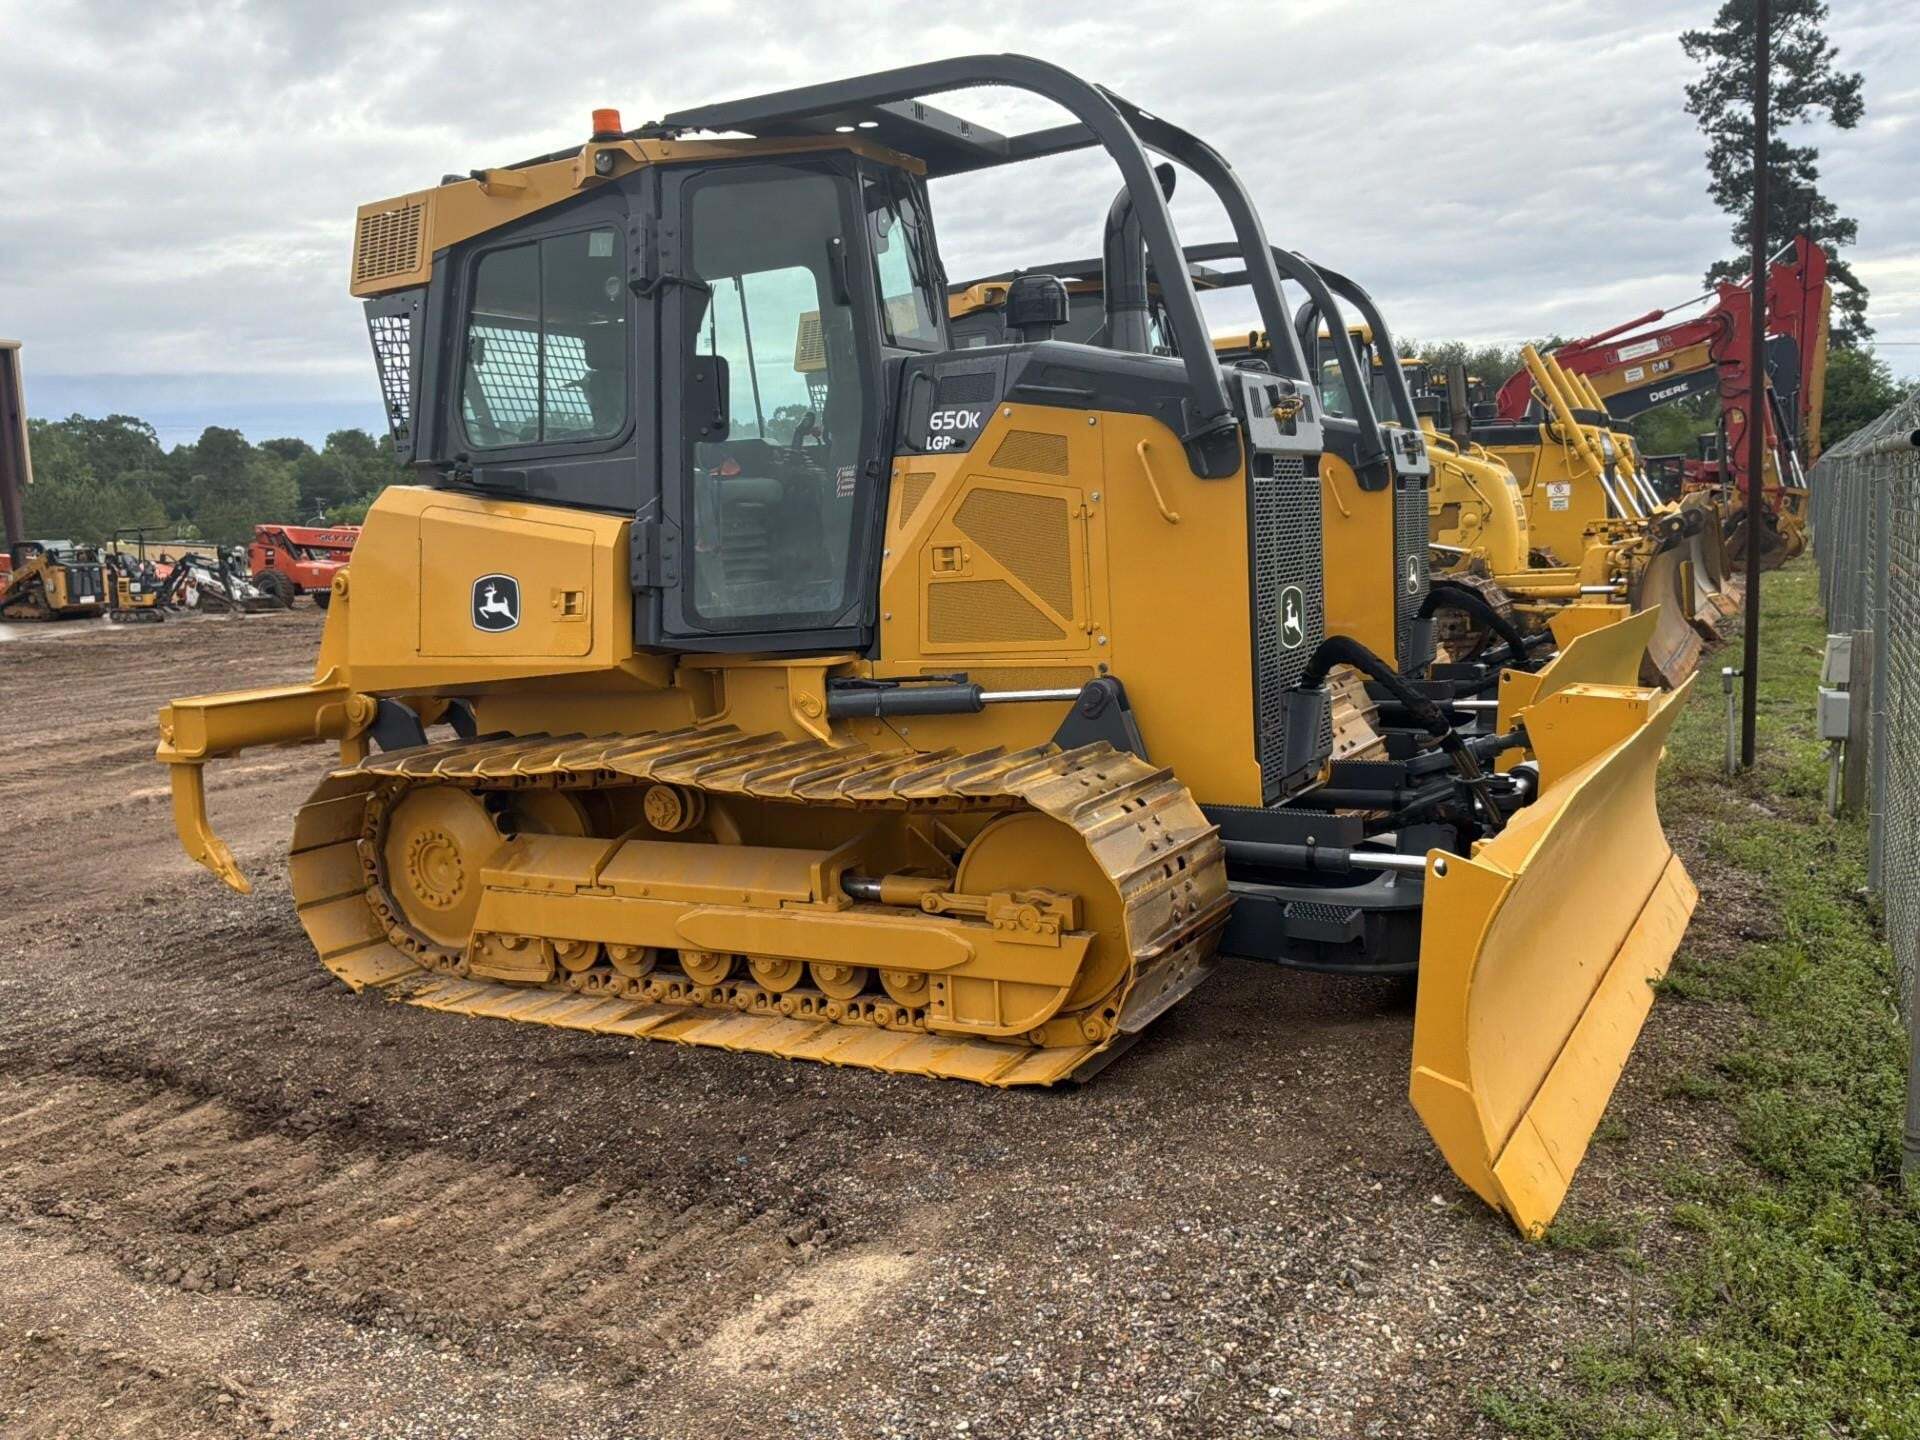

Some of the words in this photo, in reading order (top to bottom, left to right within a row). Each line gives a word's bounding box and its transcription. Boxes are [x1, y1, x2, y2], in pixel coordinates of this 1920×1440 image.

[1652, 360, 1670, 373] CAT
[1649, 383, 1689, 402] DEERE
[930, 410, 981, 430] 650K
[926, 435, 951, 450] LGP
